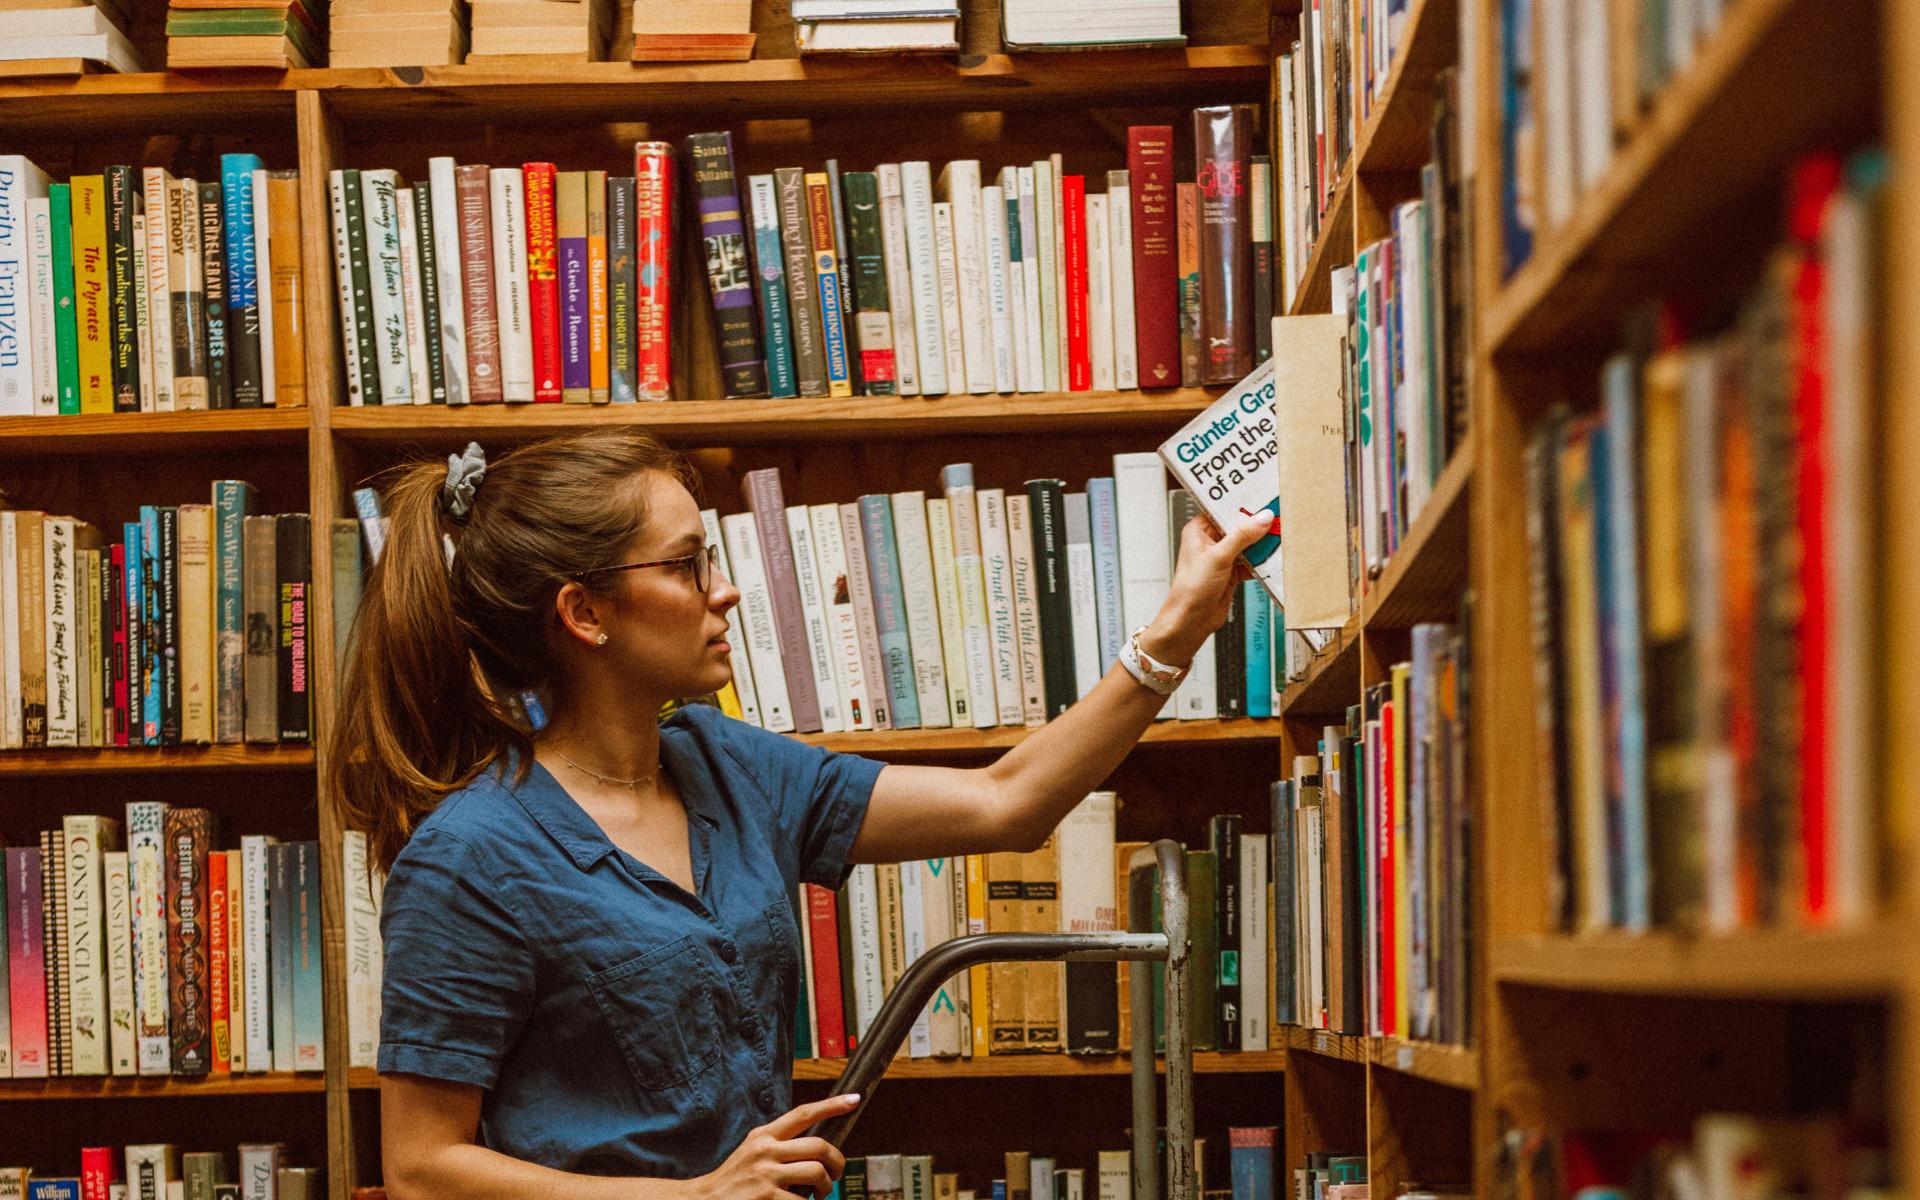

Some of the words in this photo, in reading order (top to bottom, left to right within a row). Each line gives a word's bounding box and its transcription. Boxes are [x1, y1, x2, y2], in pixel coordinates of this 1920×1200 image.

[83, 187, 94, 216] Fraser
[112, 172, 124, 205] Michael
[146, 174, 162, 239] MICHAEL
[225, 172, 238, 238] CHARLES
[239, 172, 256, 225] COLD
[615, 186, 625, 217] AMITAV
[783, 173, 802, 241] Storming
[112, 207, 124, 232] Frayn
[170, 188, 184, 256] ENTROPY
[183, 188, 197, 253] AGAINST
[203, 203, 219, 255] MICHAEL
[527, 172, 541, 247] CHROMOSOME
[35, 213, 47, 249] Caro
[115, 242, 125, 253] A
[332, 186, 342, 214] THE
[337, 228, 346, 270] BOOK
[342, 285, 349, 302] OF
[418, 187, 431, 263] EXTRAORDINARY
[425, 266, 434, 303] PEOPLE
[616, 219, 626, 249] GHOSH
[85, 247, 99, 273] The
[136, 248, 145, 271] THE
[227, 242, 241, 303] FRAZIER
[789, 246, 808, 300] Heaven
[991, 237, 1001, 270] ELLEN
[36, 254, 49, 298] Fraser
[115, 256, 129, 305] Landing
[137, 275, 146, 294] TIN
[206, 261, 222, 299] FRAYN
[243, 233, 259, 336] MOUNTAIN
[347, 184, 361, 268] SYLVIE
[356, 289, 373, 395] GERMAIN
[567, 260, 579, 302] Circle
[592, 259, 603, 311] Shadow
[615, 282, 626, 300] THE
[822, 276, 837, 309] GOOD
[993, 273, 1003, 313] FOSTER
[0, 260, 20, 368] Franzen
[83, 280, 101, 342] Pyrates
[118, 306, 127, 322] on
[138, 297, 147, 327] MEN
[841, 287, 852, 313] Moon
[118, 323, 130, 342] the
[208, 319, 224, 357] SPIES
[569, 315, 581, 363] Reason
[593, 315, 605, 353] Lines
[615, 304, 627, 344] HUNGRY
[826, 310, 840, 339] KING
[119, 343, 132, 368] Sun
[616, 349, 627, 371] TIDE
[828, 339, 844, 378] HARRY
[1176, 408, 1240, 463] Günter
[1239, 383, 1275, 414] Gra
[1190, 443, 1243, 484] From
[1237, 418, 1274, 446] the
[1208, 476, 1230, 501] of
[1228, 469, 1244, 484] a
[1240, 436, 1278, 473] Sna
[218, 485, 236, 510] Rip
[986, 497, 998, 529] Gilchrist
[1010, 499, 1023, 531] Gilchrist
[1041, 490, 1050, 514] ELLEN
[163, 512, 172, 557] Columbus
[223, 512, 236, 538] Van
[846, 514, 857, 542] Ellen
[1043, 513, 1054, 552] GILCHRIST
[1100, 489, 1111, 549] GILCHRIST
[223, 539, 239, 590] Winkle
[989, 555, 1005, 602] Drunk
[1014, 557, 1030, 604] Drunk
[1104, 560, 1112, 569] A
[128, 568, 139, 620] COLUMBUS
[164, 559, 173, 610] Slaughters
[292, 582, 304, 599] THE
[1104, 571, 1117, 634] DANGEROUS
[165, 612, 173, 644] Braves
[292, 601, 304, 624] ROAD
[293, 626, 304, 638] TO
[996, 606, 1011, 645] With
[1020, 608, 1035, 646] With
[129, 621, 139, 684] SLAUGHTERS
[840, 613, 861, 690] RHODA
[998, 648, 1013, 682] Love
[1023, 650, 1038, 684] Love
[1107, 637, 1118, 660] AGE
[889, 647, 904, 700] Gilchrist
[929, 665, 940, 686] Ellen
[972, 653, 985, 696] Gilchrist
[130, 686, 140, 724] BRAVES
[178, 837, 194, 880] DESTINY
[70, 836, 91, 984] CONSTANCIA
[110, 872, 127, 982] CONSTANCIA
[180, 898, 196, 934] DESIRE
[211, 889, 224, 945] CARLOS
[889, 904, 897, 931] ISLAND
[183, 944, 195, 981] CARLOS
[212, 950, 224, 1013] FUENTES
[216, 1024, 228, 1058] USED
[36, 1185, 71, 1199] William
